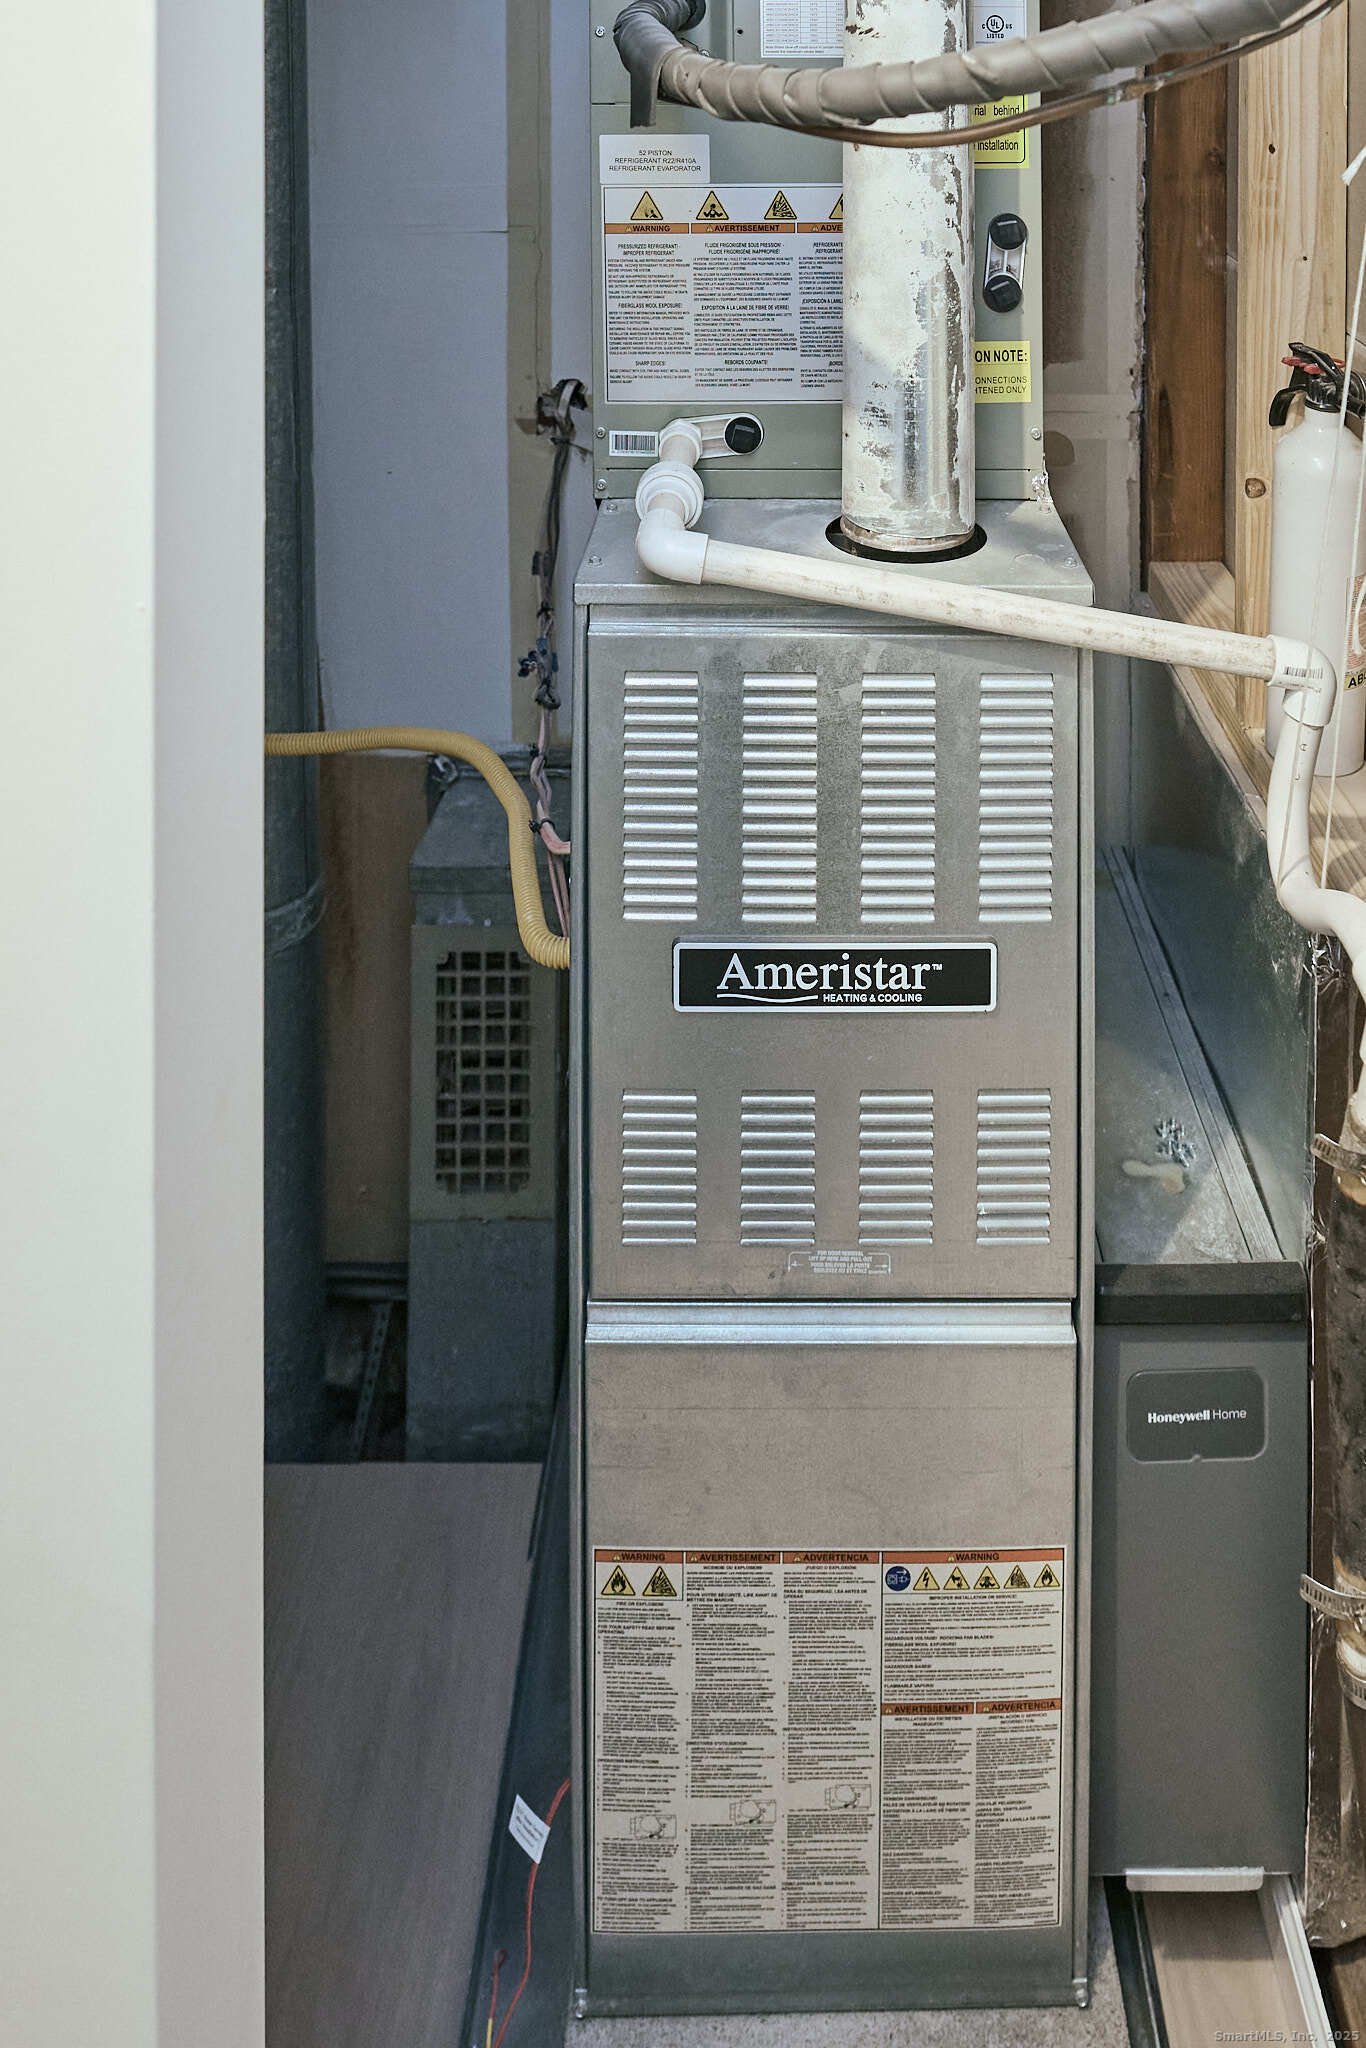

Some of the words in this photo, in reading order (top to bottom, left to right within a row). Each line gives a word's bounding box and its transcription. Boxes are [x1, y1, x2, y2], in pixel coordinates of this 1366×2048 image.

[990, 19, 1000, 29] UL
[975, 105, 986, 115] rial
[993, 105, 1019, 115] behind
[977, 140, 1019, 151] installation
[714, 224, 780, 232] AVERTISSEMENT
[820, 224, 843, 232] ADVE
[975, 350, 990, 362] ON
[993, 349, 1027, 362] NOTE:
[975, 376, 1027, 384] ONNECTIONS
[1006, 386, 1026, 394] ONLY
[823, 993, 867, 1003] HEATING
[869, 993, 876, 1003] &
[878, 993, 922, 1003] COOLING
[1147, 1410, 1210, 1424] Honeywell
[1212, 1409, 1247, 1420] Home
[700, 1553, 776, 1561] AVERTISSEMENT
[803, 1553, 869, 1561] ADVERTENCIA
[955, 1553, 1000, 1561] WARNING
[894, 1705, 968, 1713] AVERTISSEMENT
[992, 1701, 1055, 1711] ADVERTENCIA
